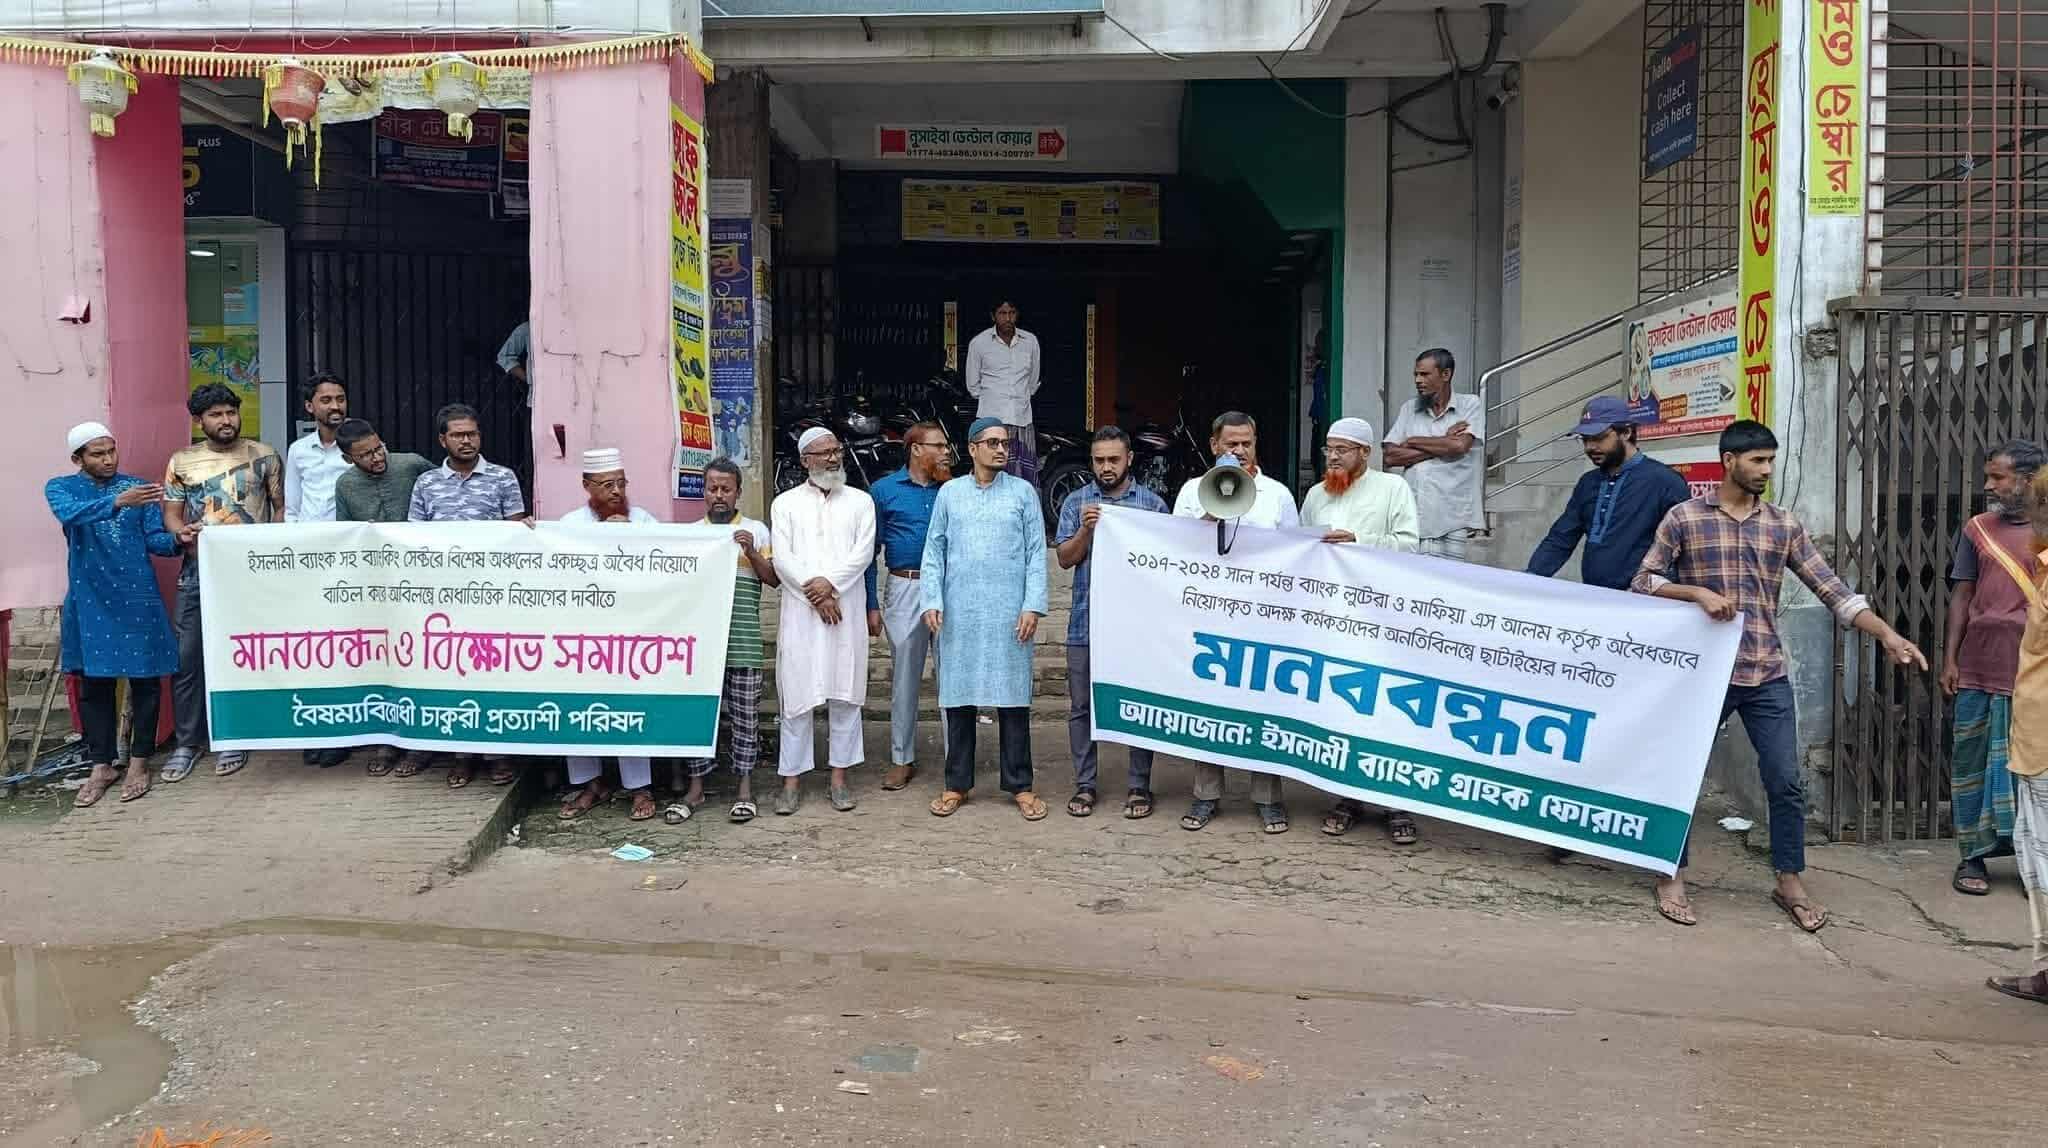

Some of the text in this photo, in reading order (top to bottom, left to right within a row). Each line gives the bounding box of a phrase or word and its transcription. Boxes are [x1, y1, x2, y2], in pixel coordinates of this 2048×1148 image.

[1651, 101, 1692, 137] cash here
[1657, 80, 1686, 111] Collect
[197, 137, 221, 147] PLUS
[909, 126, 950, 148] নুসাইবা
[953, 127, 993, 145] ডেন্টাল
[996, 130, 1033, 146] কেয়ার
[1748, 40, 1779, 257] হোমিও
[1816, 84, 1858, 194] চেম্বার
[1647, 321, 1675, 355] নুসাইবা
[1677, 312, 1706, 343] ডেন্টাল
[1708, 306, 1737, 335] কেয়ার
[1744, 290, 1772, 425] চেম্বা
[248, 546, 295, 573] ইসলামী
[299, 552, 335, 571] ব্যাংক
[339, 551, 357, 569] সহ
[403, 546, 443, 568] সেক্টরে
[447, 545, 485, 568] বিশেষ
[489, 551, 542, 569] অঞ্চলের
[603, 544, 645, 573] অবৈধ
[649, 549, 699, 573] নিয়োগে
[322, 580, 363, 605] বাতিল
[388, 580, 434, 606] অবিলম্বে
[438, 581, 504, 606] মেধাভিত্তিক
[509, 582, 566, 608] নিয়োগের
[572, 584, 616, 609] দাবীতে
[1127, 551, 1701, 671] ২০১৭-২০২৪ সাল পর্যন্ত ব্যাংক লুটেরা ও মাফিয়া এস আলম কর্তৃক অবৈধভাবে
[230, 612, 697, 680] মানববন্ধন ও বিক্ষোভ সমাবেশ
[1182, 585, 1617, 689] নিয়োগকৃত অদক্ষ কর্মকর্তাদের অনতিবিলম্বে ছাটাইয়ের দাবীতে
[292, 693, 646, 736] বৈষম্যবিরোধী চাকুরী প্রত্যাশী পরিষদ
[1193, 631, 1597, 763] মানববন্ধন
[1119, 700, 1647, 840] আয়োজনে: ইসলামী ব্যাংক গ্রাহক ফোরাম
